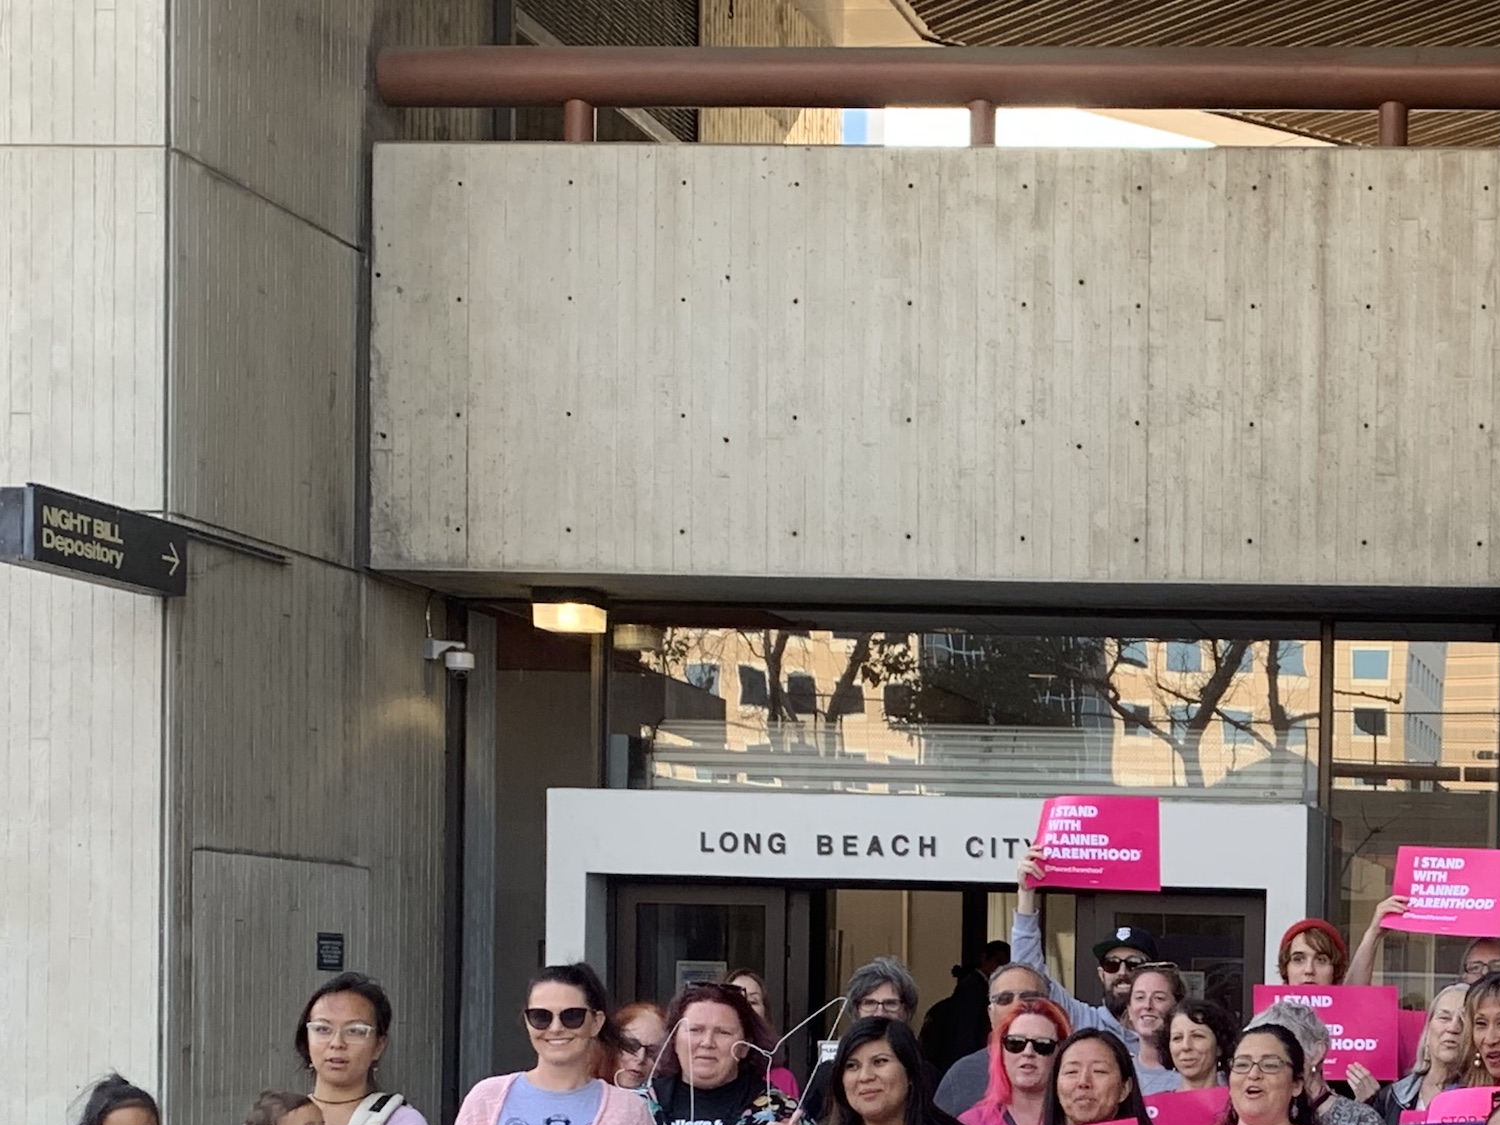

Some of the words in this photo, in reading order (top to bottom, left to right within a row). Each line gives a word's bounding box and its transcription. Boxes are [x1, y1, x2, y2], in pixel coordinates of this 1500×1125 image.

[42, 505, 91, 535] NIGHT
[93, 519, 124, 545] BILL
[42, 528, 124, 569] Depository
[1055, 805, 1098, 818] STAND
[1048, 819, 1081, 832] WITH
[700, 832, 787, 855] LONG
[816, 834, 937, 858] BEACH
[1044, 833, 1109, 846] PLANNED
[1043, 847, 1141, 861] PARENTHOOD
[1421, 857, 1465, 870] STAND
[1413, 870, 1447, 883] WITH
[1411, 884, 1469, 897] PLANNED
[1407, 897, 1495, 911] PARENTHOOD
